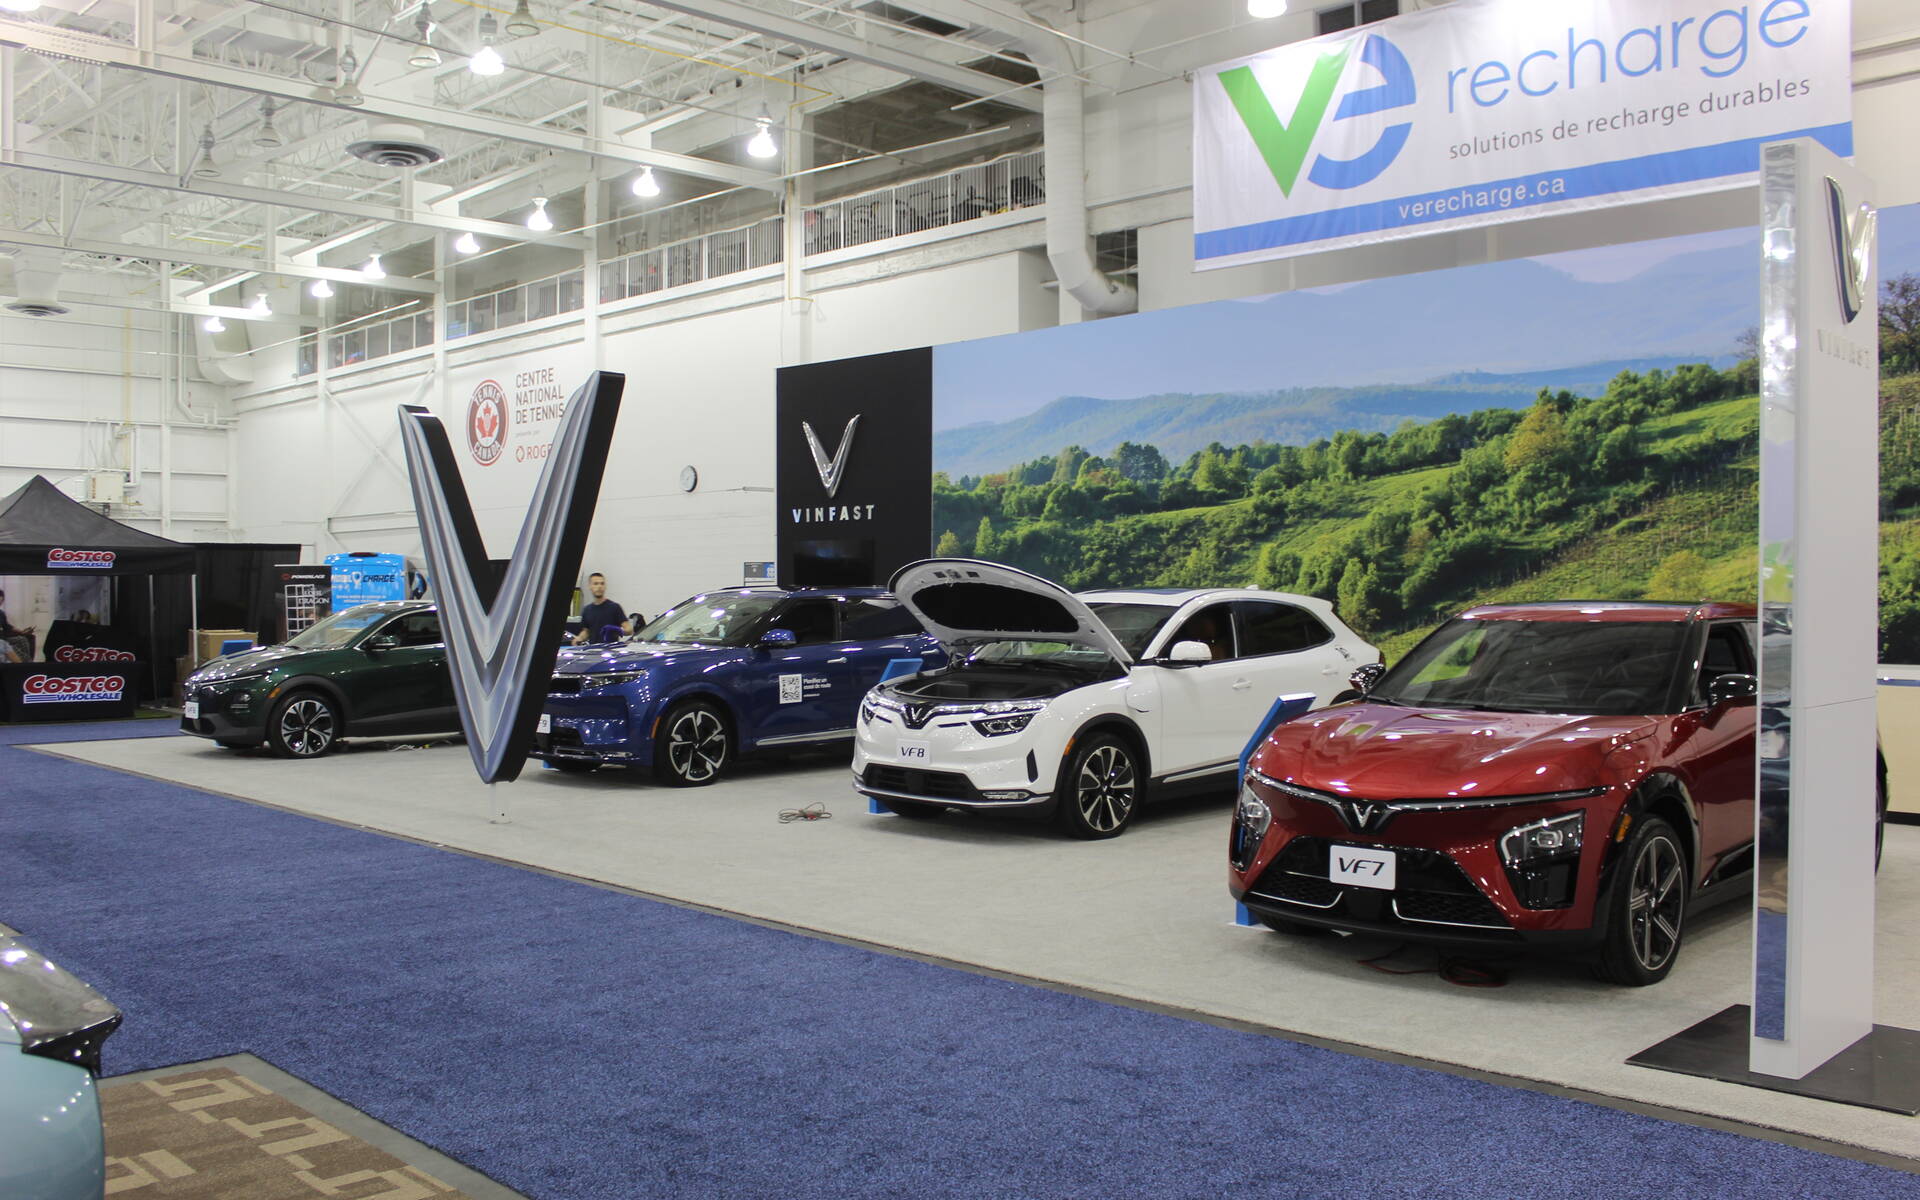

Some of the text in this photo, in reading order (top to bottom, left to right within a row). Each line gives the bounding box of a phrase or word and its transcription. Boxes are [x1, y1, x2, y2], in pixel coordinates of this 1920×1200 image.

[1447, 0, 1811, 113] recharge
[1449, 78, 1811, 160] solutions de recharge durables
[1399, 177, 1566, 219] verecharge.ca
[516, 368, 554, 388] CENTRE
[474, 384, 503, 406] TENNIS
[516, 385, 564, 407] NATIONAL
[516, 402, 564, 424] DE TENNIS
[792, 504, 875, 524] VINFAST
[48, 549, 116, 562] COSTCO
[363, 574, 396, 583] CHARGE
[54, 645, 136, 663] COSTCO
[24, 675, 124, 694] COSTCO
[57, 692, 121, 702] WHOLESALE
[901, 746, 925, 758] VF8
[1339, 856, 1385, 877] VF7
